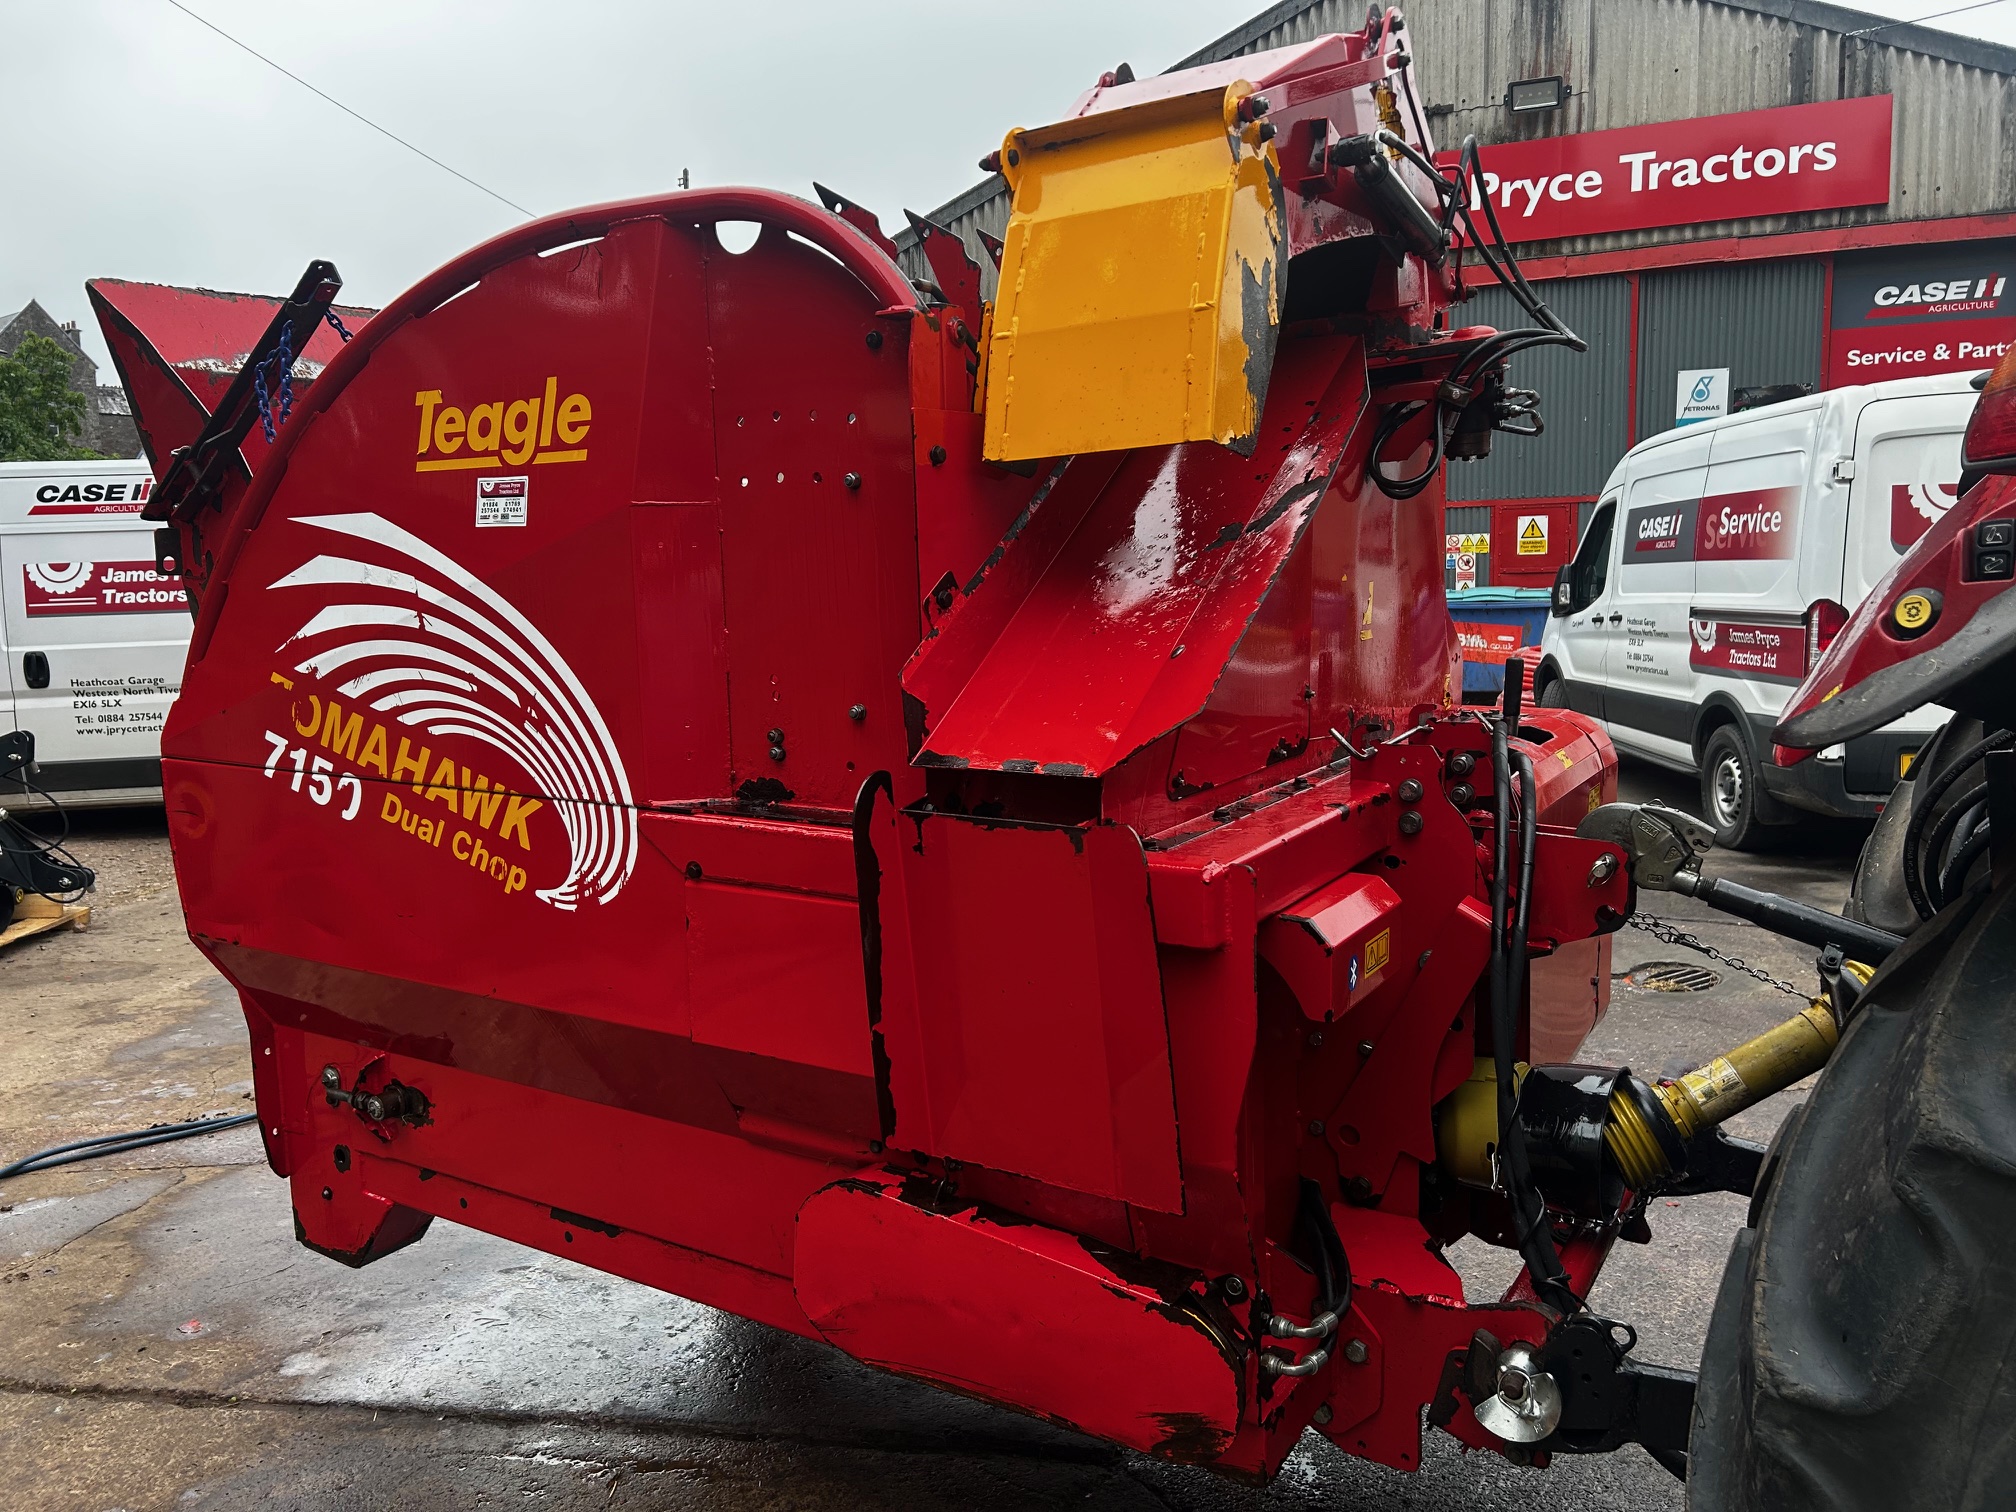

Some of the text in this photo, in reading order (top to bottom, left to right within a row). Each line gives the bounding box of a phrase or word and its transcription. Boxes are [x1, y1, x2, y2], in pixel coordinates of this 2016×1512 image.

[1470, 141, 1838, 218] Pryce Tractors
[1873, 280, 1972, 306] CASE
[1927, 300, 1995, 313] AGRICULTURE
[1847, 346, 1927, 367] Service
[1932, 342, 1952, 361] &
[1683, 404, 1720, 413] PETRONAS
[415, 376, 592, 466] Teagle
[36, 483, 127, 503] CASE
[93, 503, 145, 513] AGRICULTUR
[1638, 516, 1671, 540] CASE
[1719, 503, 1782, 536] Service
[102, 588, 188, 605] Tractors
[1728, 628, 1781, 649] James Pryce
[1728, 649, 1777, 669] Tractors Ltd
[70, 676, 165, 688] Heathcoat Garage
[72, 689, 120, 698] Westexe
[122, 687, 154, 696] North
[73, 699, 122, 709] EX16 5LX
[75, 712, 163, 724] Tel: 01884 257544
[76, 725, 164, 736] www.jprycetract
[381, 792, 528, 895] Dual Chop
